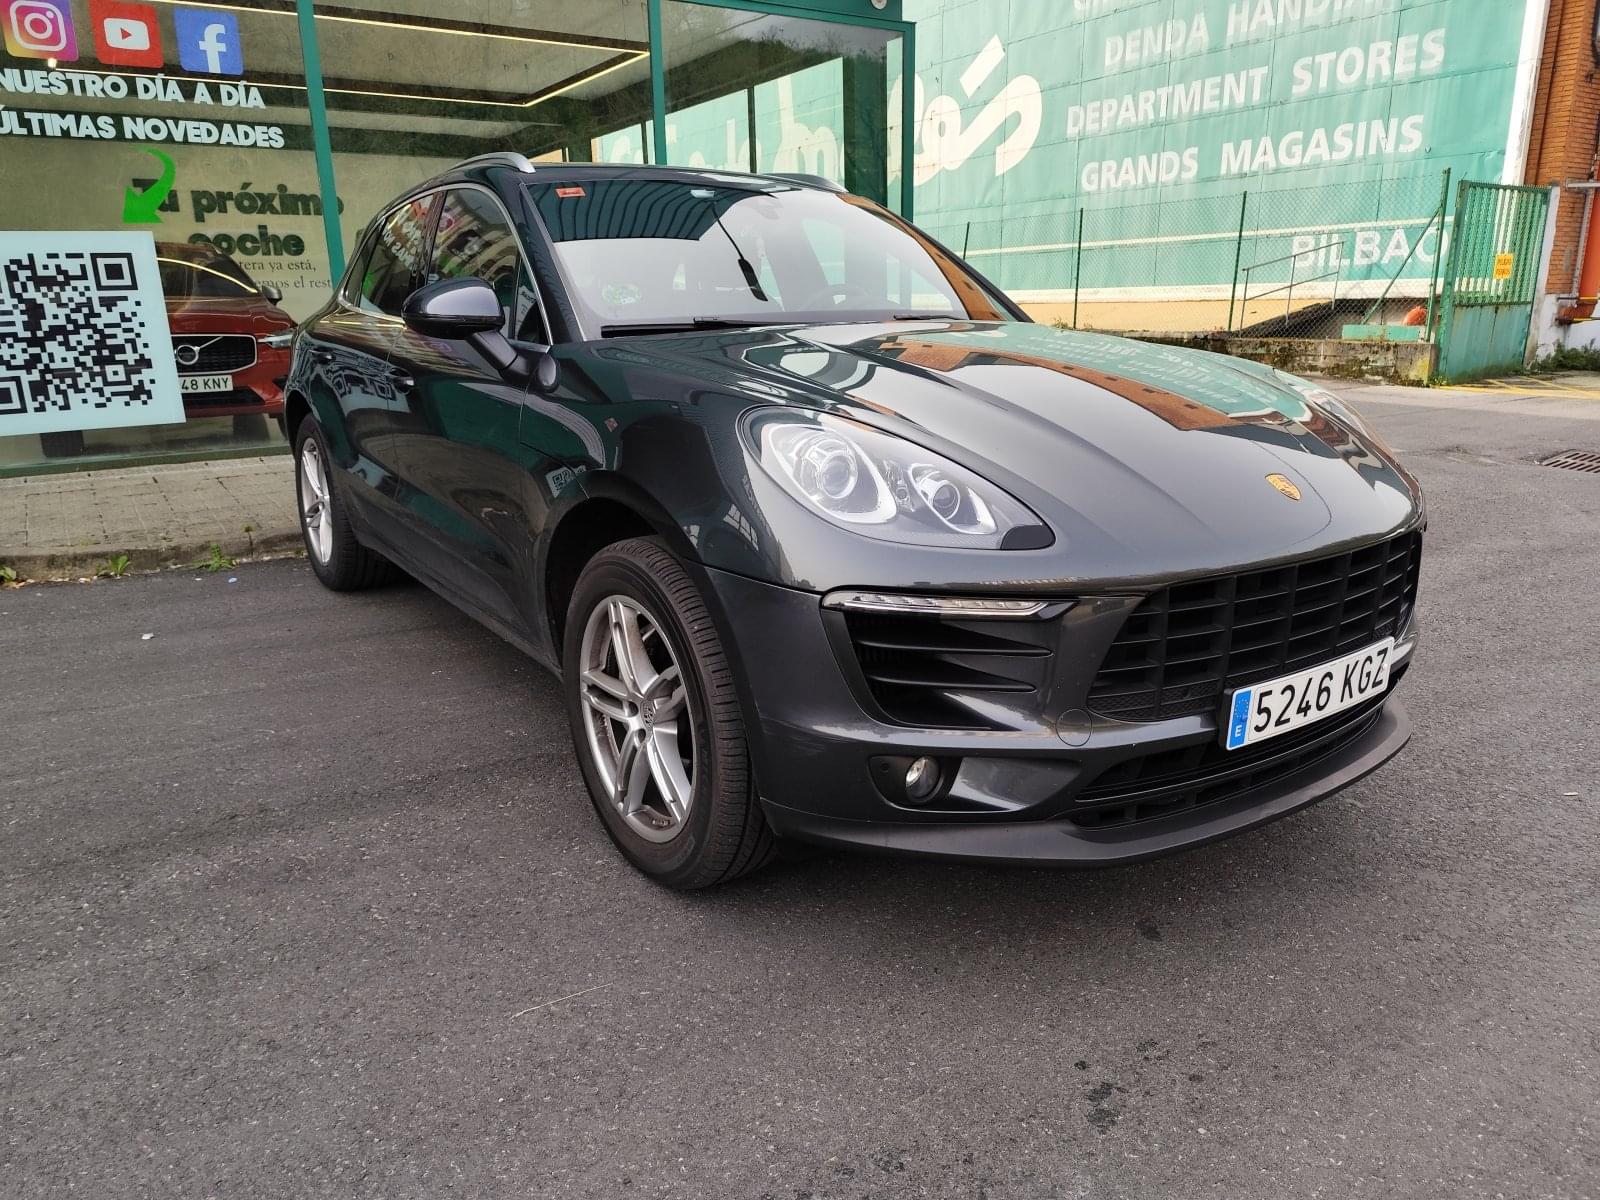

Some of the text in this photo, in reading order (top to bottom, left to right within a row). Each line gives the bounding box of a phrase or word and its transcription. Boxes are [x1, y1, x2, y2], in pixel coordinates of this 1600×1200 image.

[1105, 11, 1209, 66] DENDA
[0, 68, 266, 109] NUESTRO DÍA A DÍA
[1067, 28, 1446, 136] DEPARTMENT STORES
[122, 116, 285, 149] NOVEDADES
[1081, 114, 1424, 192] GRANDS MAGASINS
[268, 262, 283, 273] ya
[287, 259, 317, 272] está,
[1291, 227, 1449, 268] BILBAO
[293, 276, 305, 288] el
[202, 377, 229, 390] KNY
[1253, 647, 1389, 733] 5246 KGZ
[1234, 724, 1243, 738] E
